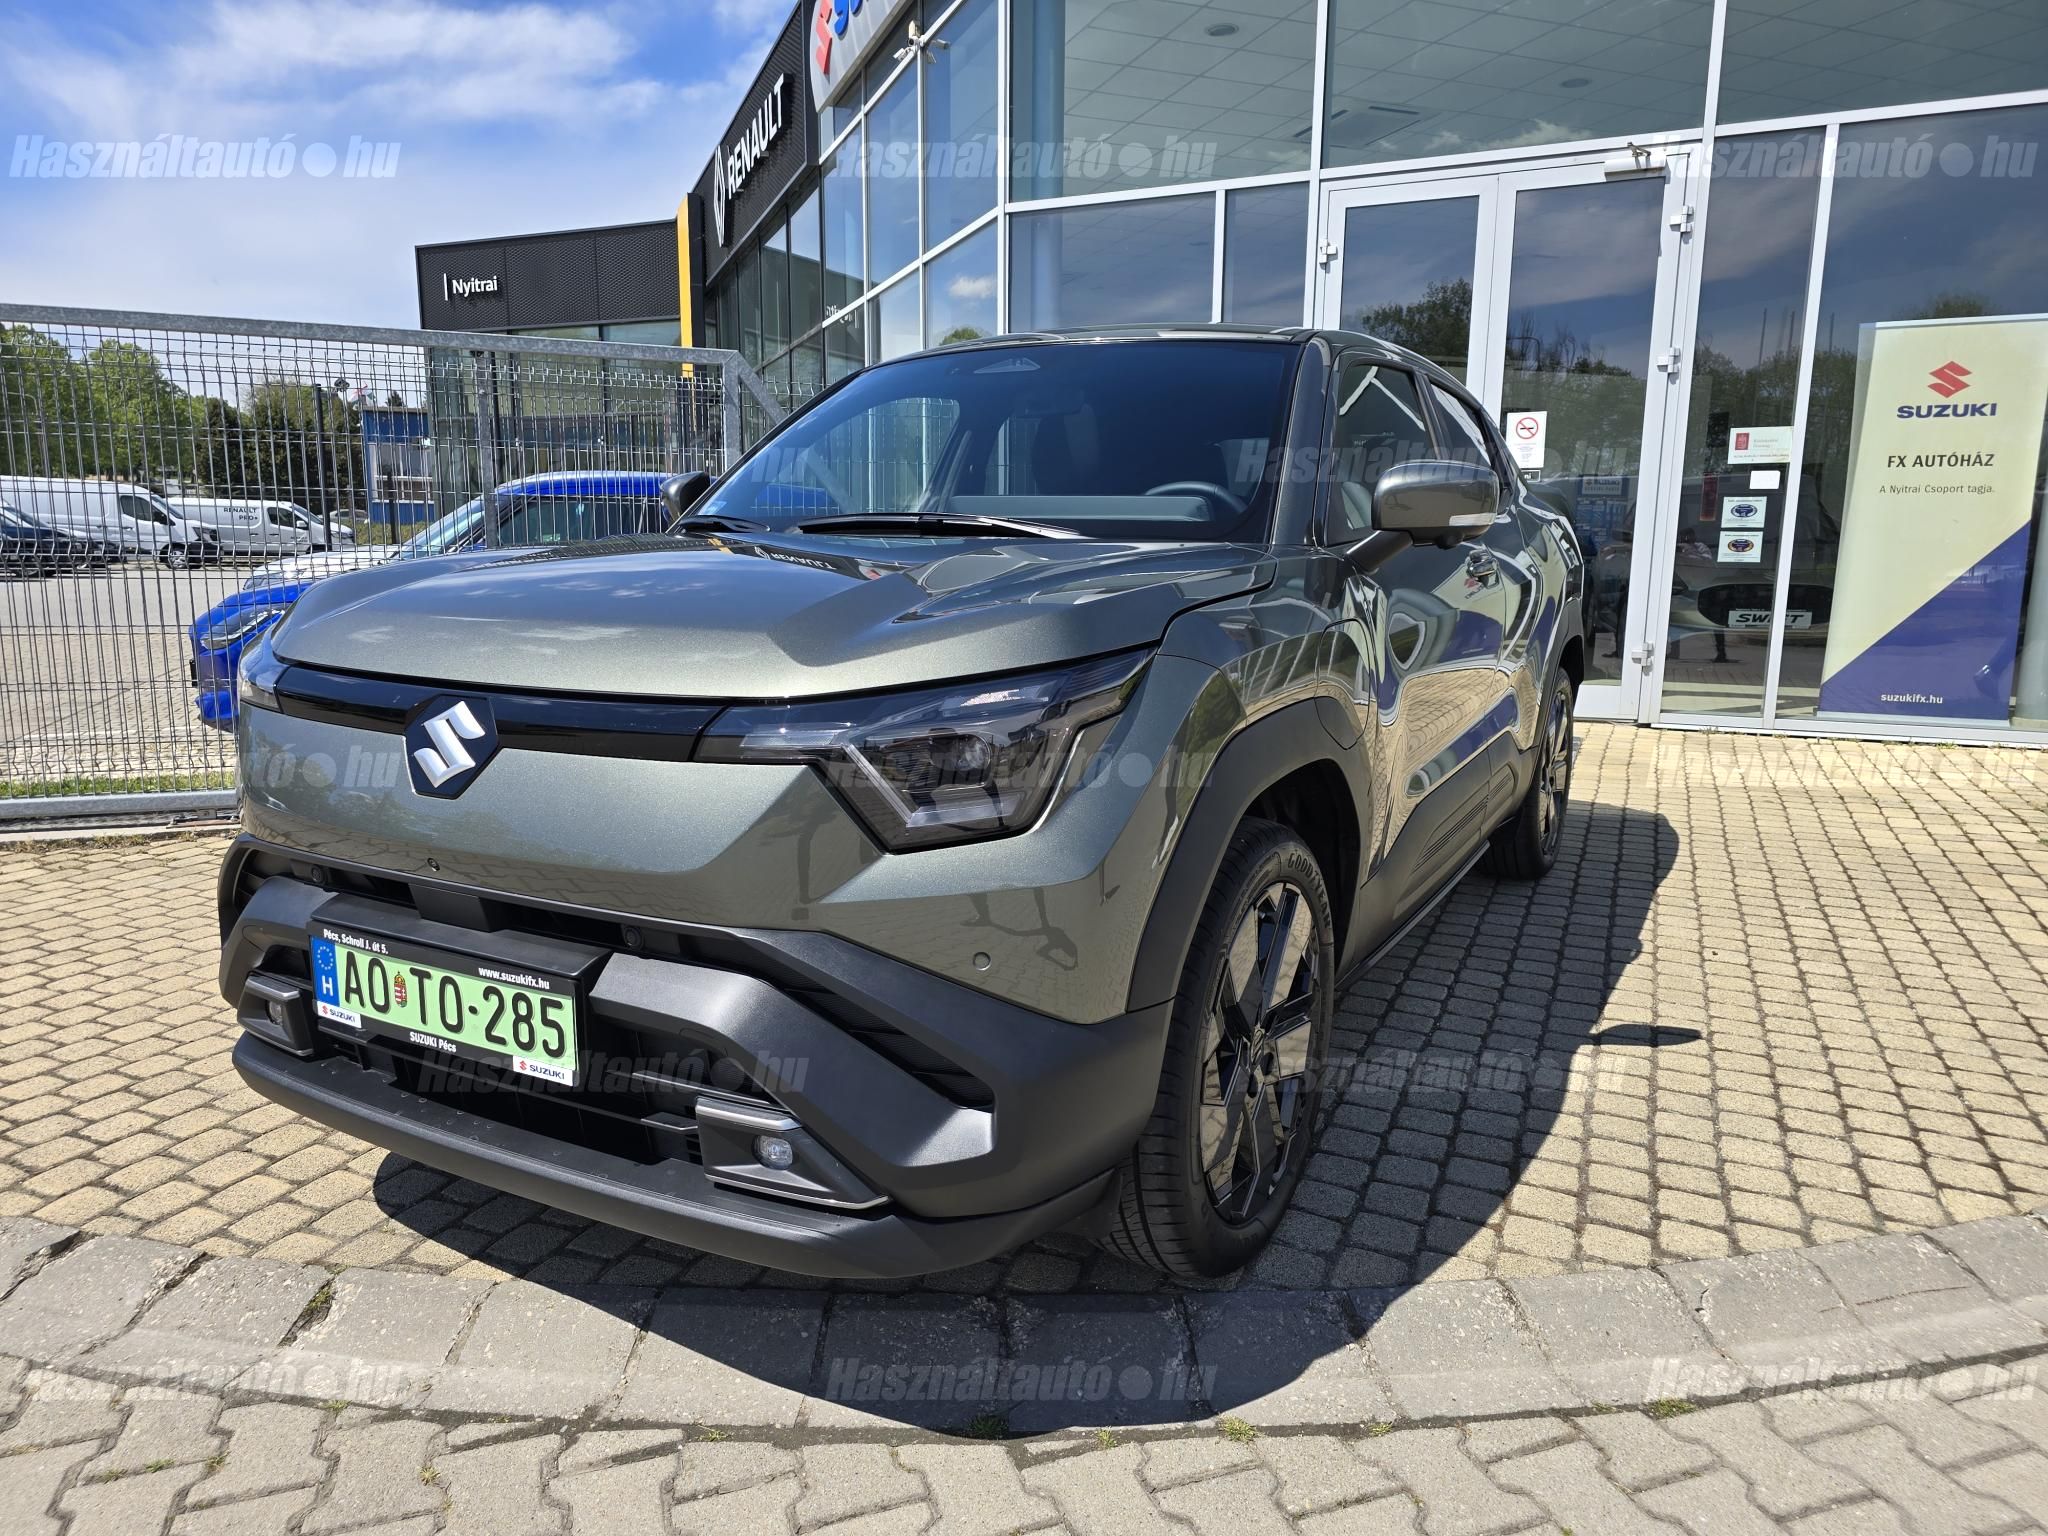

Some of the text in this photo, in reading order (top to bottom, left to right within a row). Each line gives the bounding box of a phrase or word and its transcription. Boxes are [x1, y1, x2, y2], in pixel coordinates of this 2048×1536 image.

[727, 73, 786, 200] RENAULT
[452, 275, 498, 297] Nyitrai
[1896, 403, 1998, 419] SUZUKI
[1887, 453, 1996, 468] FX AUTÓHÁZ
[1879, 484, 1996, 496] A Nyitrai Csoport tagja.
[1880, 692, 1944, 705] suzukifx.hu
[323, 929, 341, 944] Pécs,
[342, 933, 365, 949] Schroll
[372, 941, 381, 953] út
[381, 944, 389, 955] 5.
[321, 975, 334, 997] H
[344, 950, 391, 1014] AO
[478, 967, 550, 990] www.suzukifx.hu
[329, 1007, 356, 1024] SUZUKI
[410, 1032, 457, 1053] SUZUKI Pécs
[529, 1063, 566, 1080] SUZUKI
